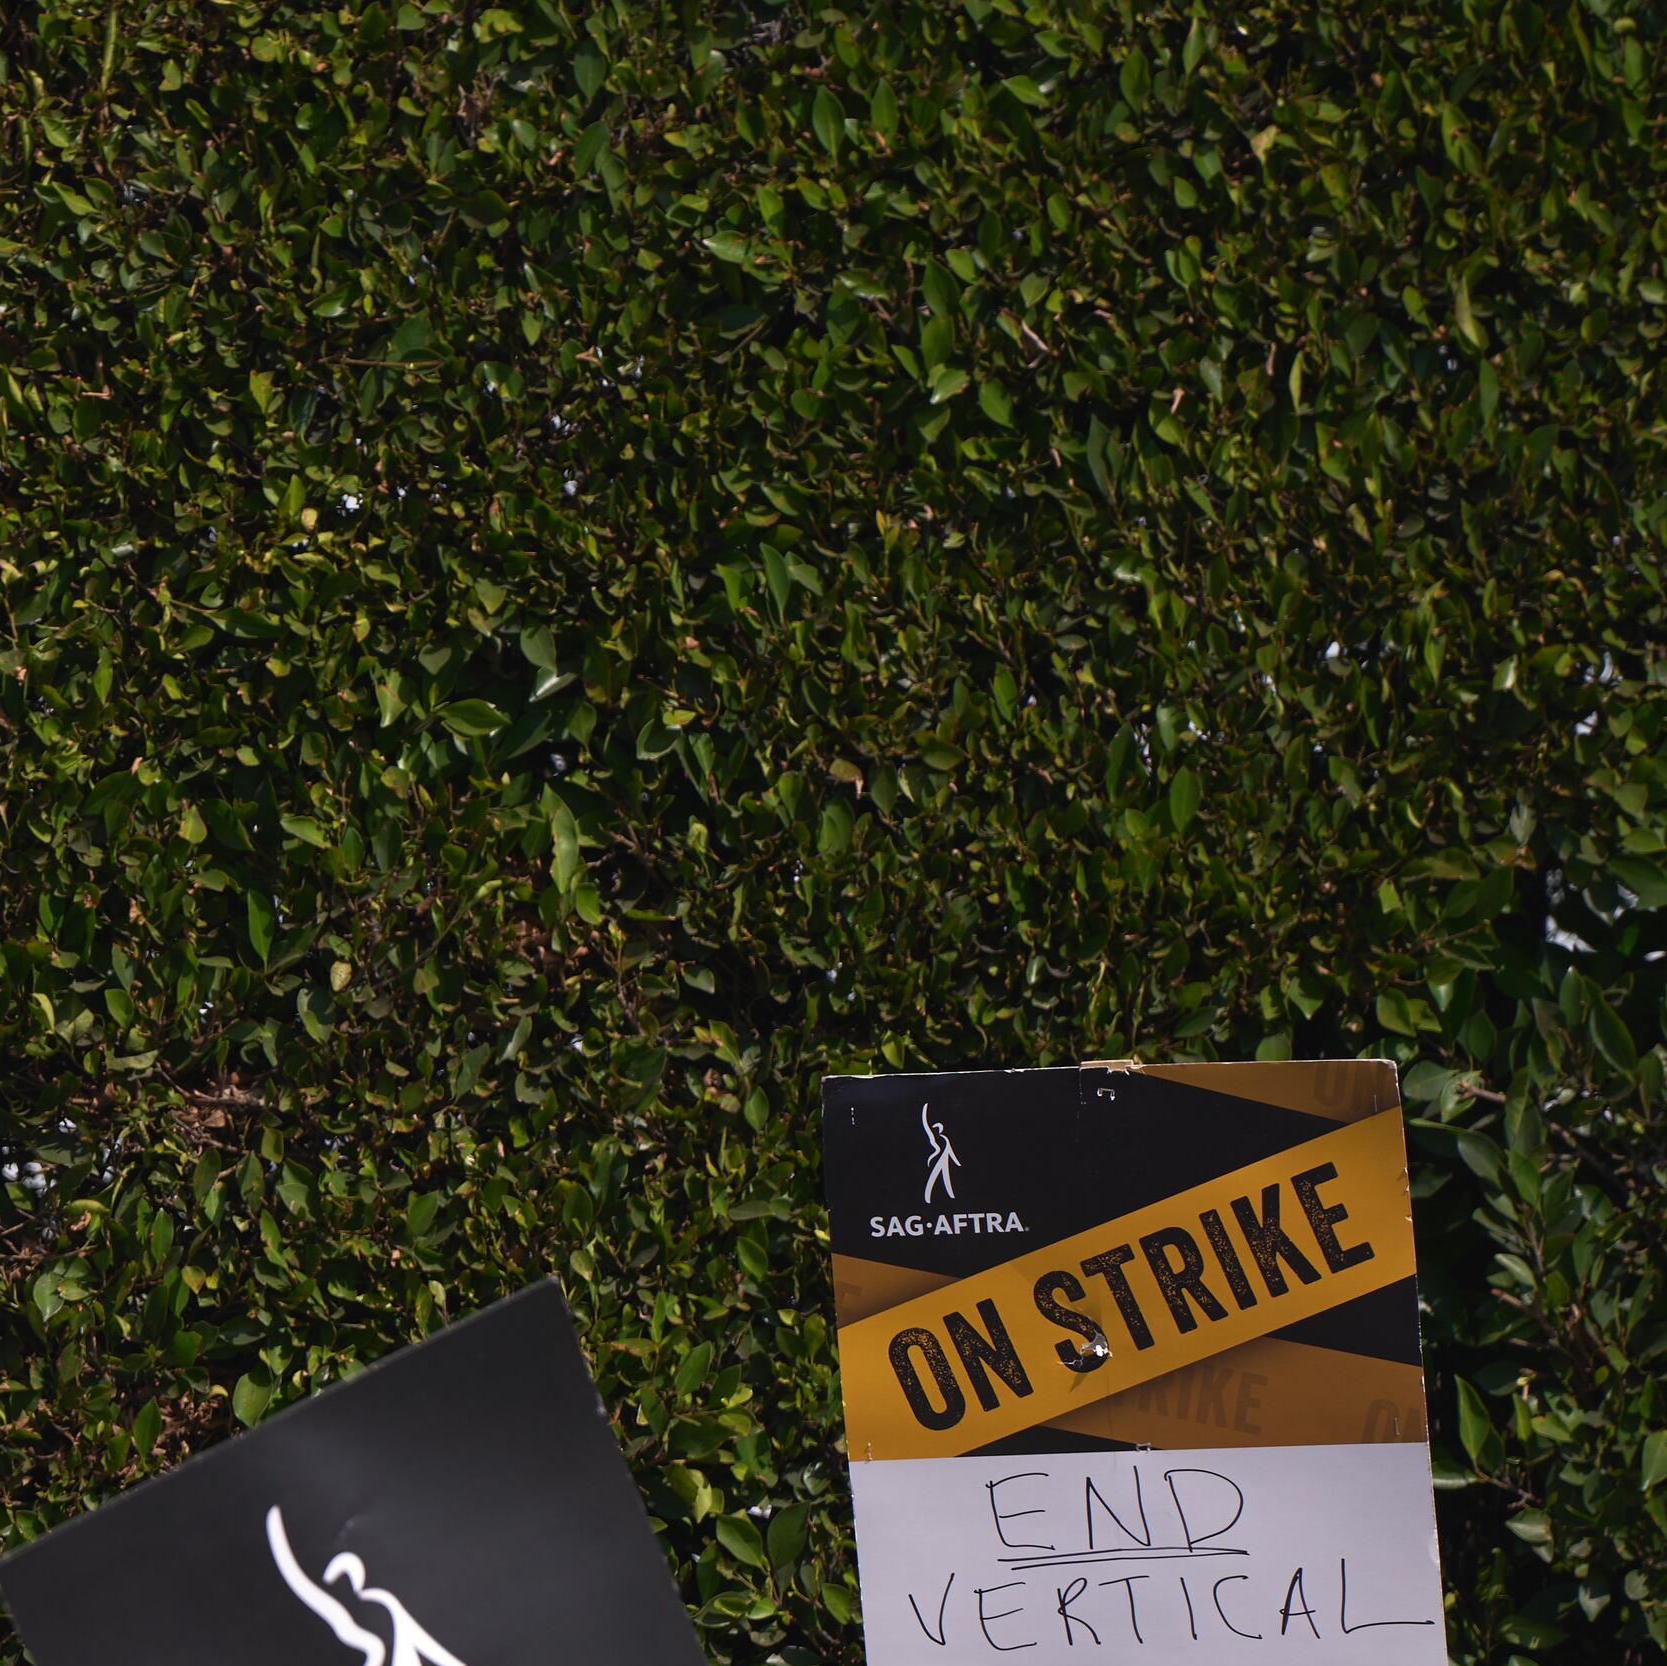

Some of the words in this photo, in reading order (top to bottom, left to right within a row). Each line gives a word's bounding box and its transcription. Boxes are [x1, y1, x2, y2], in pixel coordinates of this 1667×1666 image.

[888, 1298, 1034, 1432] ON
[1032, 1161, 1375, 1374] STRIKE
[985, 1465, 1244, 1553] END
[909, 1557, 1435, 1652] VERTICAL
